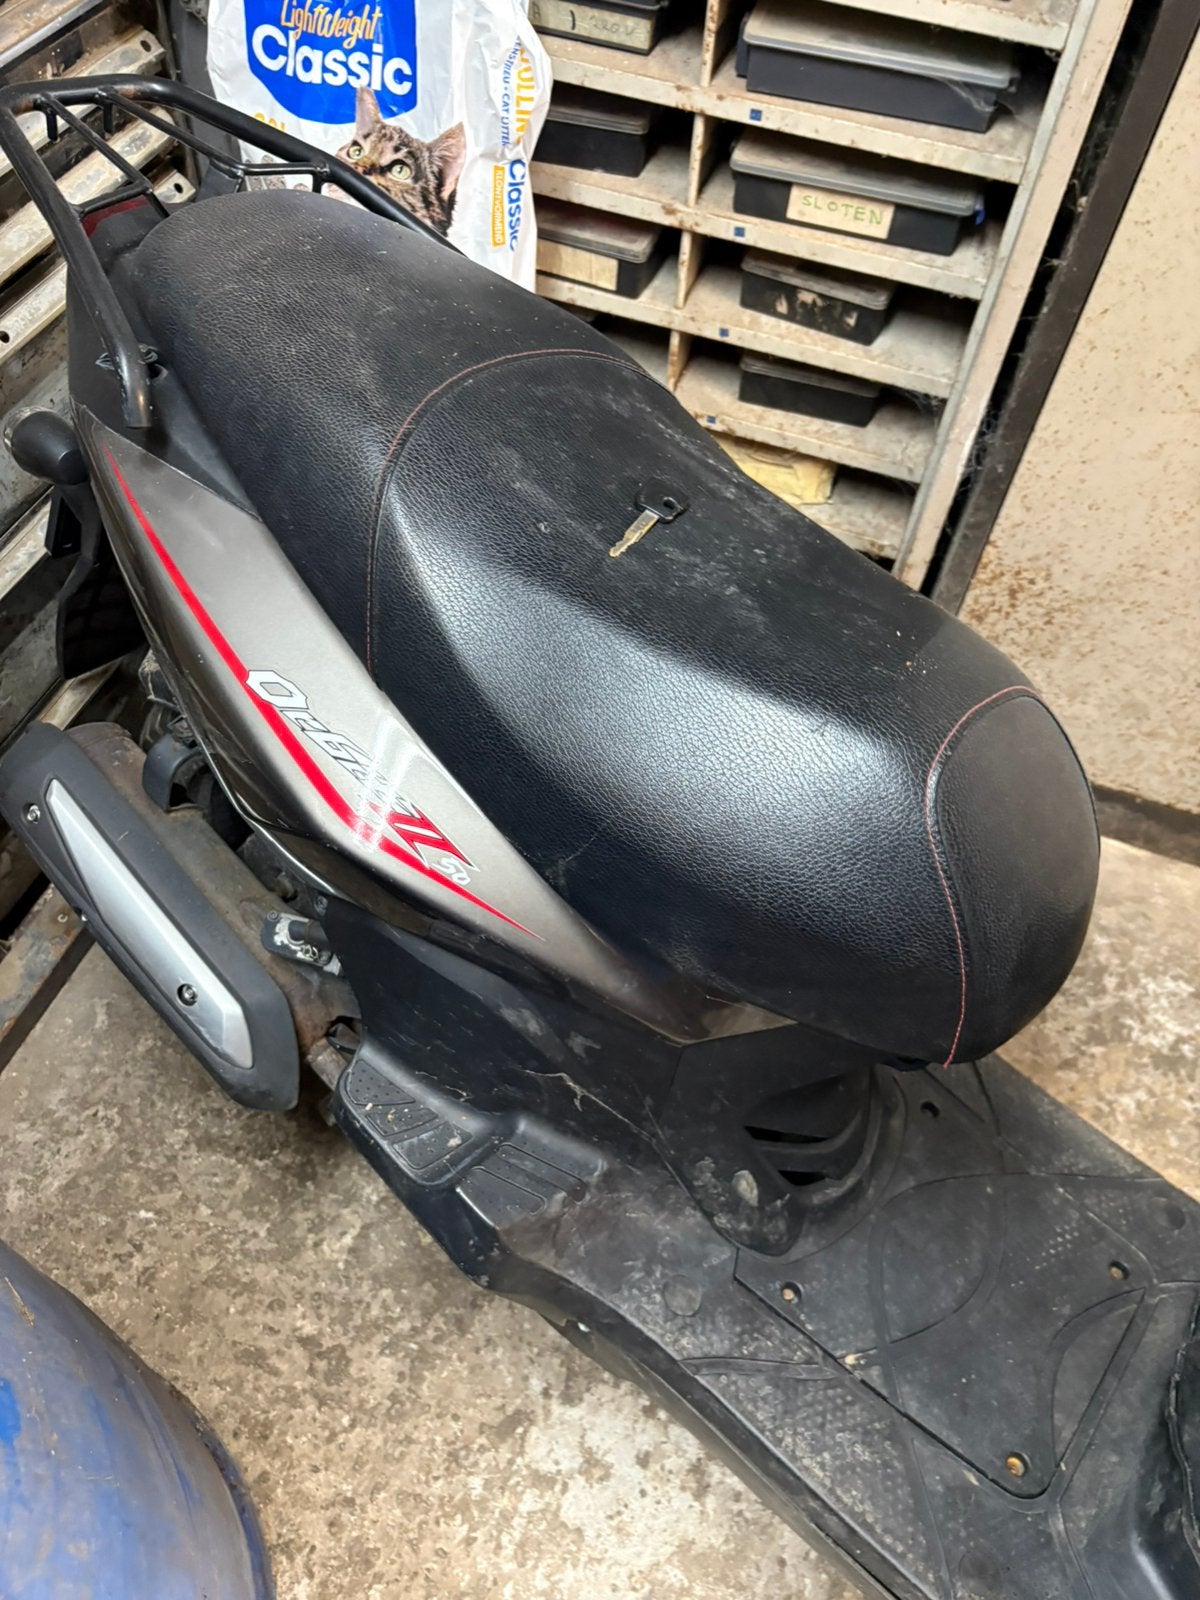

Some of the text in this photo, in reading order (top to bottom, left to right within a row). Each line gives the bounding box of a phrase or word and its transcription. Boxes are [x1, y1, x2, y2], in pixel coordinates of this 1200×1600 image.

[252, 24, 412, 96] Classic
[502, 93, 511, 114] CAT
[508, 159, 526, 252] Classic
[801, 195, 884, 225] SLOTEN
[432, 857, 471, 886] 50
